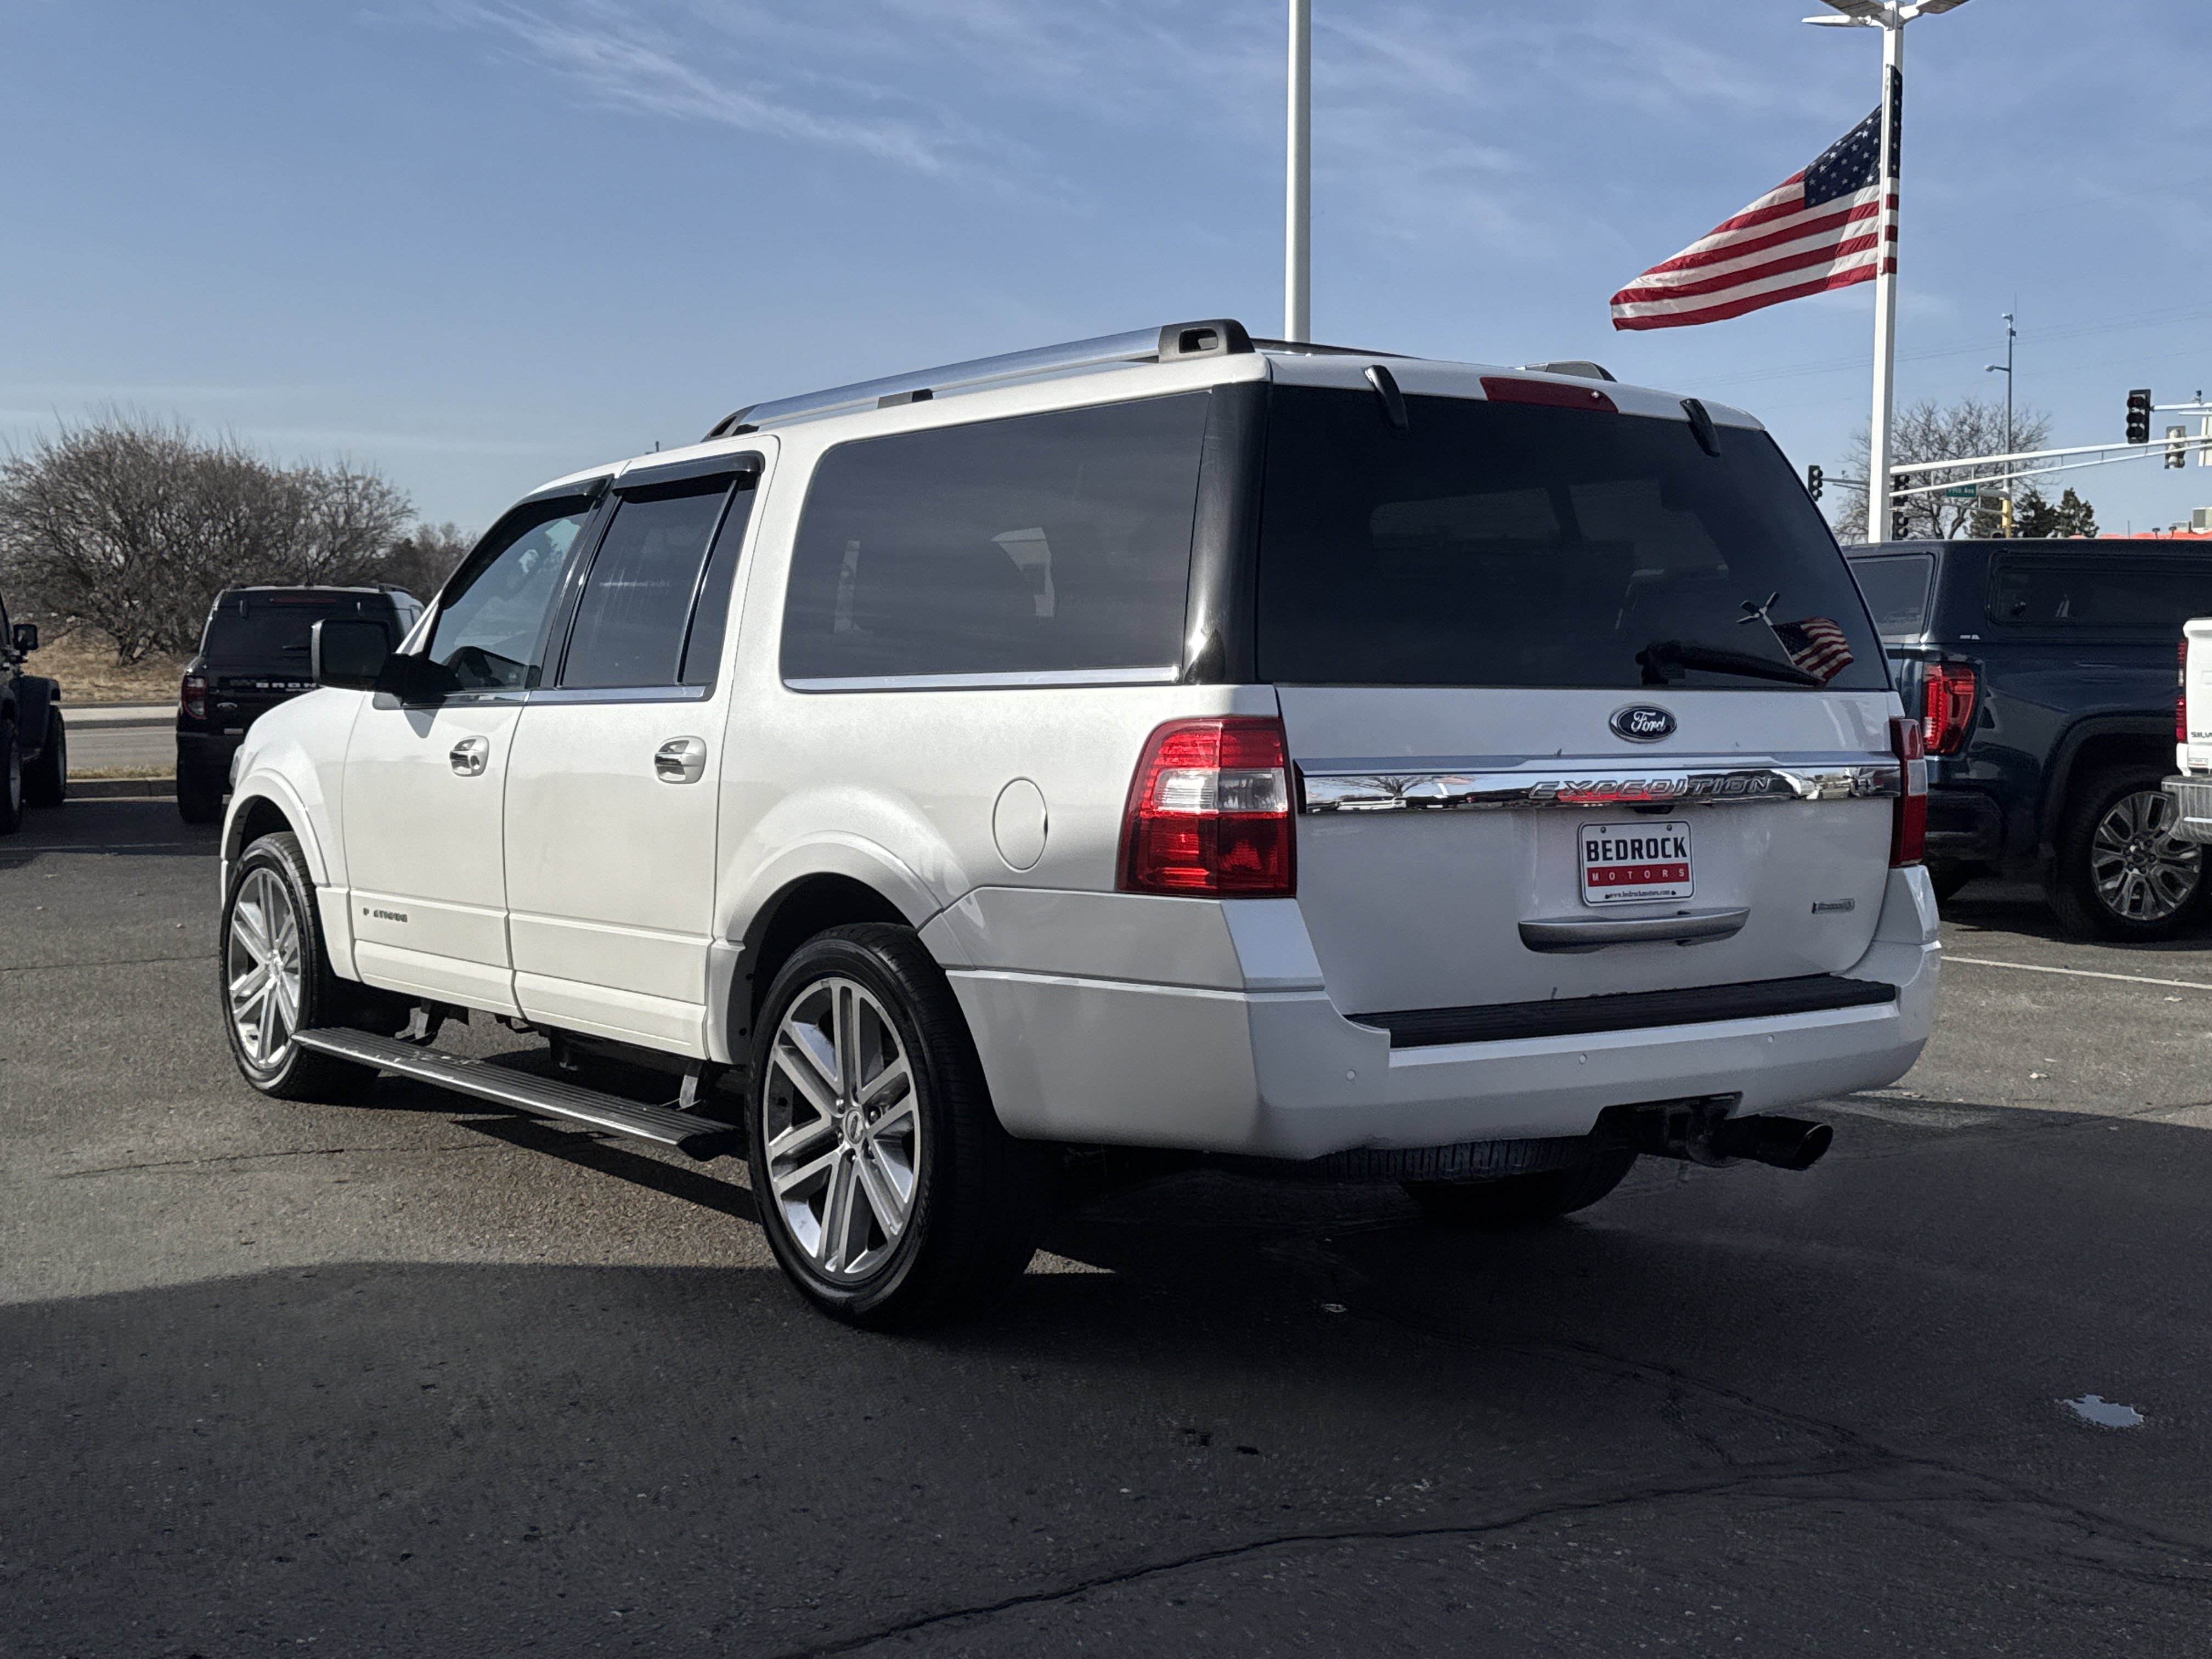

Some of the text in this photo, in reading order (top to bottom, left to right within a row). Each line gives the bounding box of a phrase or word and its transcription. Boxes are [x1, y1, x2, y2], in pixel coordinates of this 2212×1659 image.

[1630, 710, 1667, 732] Ford
[1528, 775, 1772, 800] EXPEDITION
[1585, 837, 1688, 862] BEDROCK
[1592, 868, 1685, 881] MOTORS
